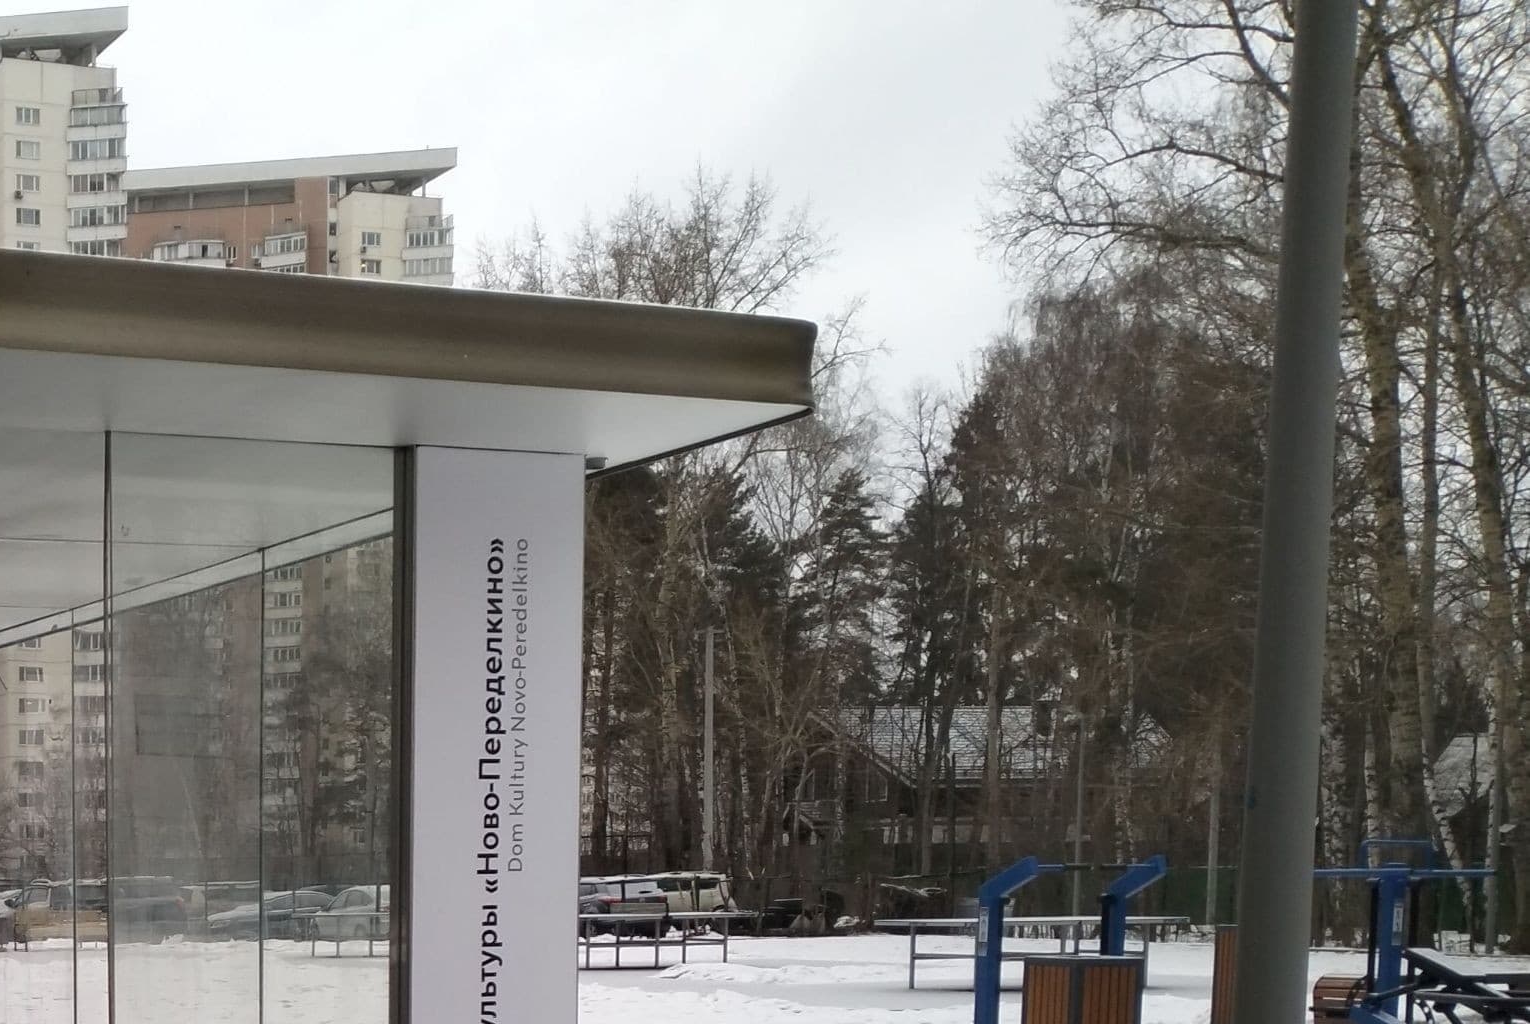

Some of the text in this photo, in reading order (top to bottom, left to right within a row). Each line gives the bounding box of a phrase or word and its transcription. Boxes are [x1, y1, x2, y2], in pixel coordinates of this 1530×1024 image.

[476, 537, 506, 894] «Ново-Переделкино»
[507, 538, 529, 872] Dom Kultury Novo-Peredelkino
